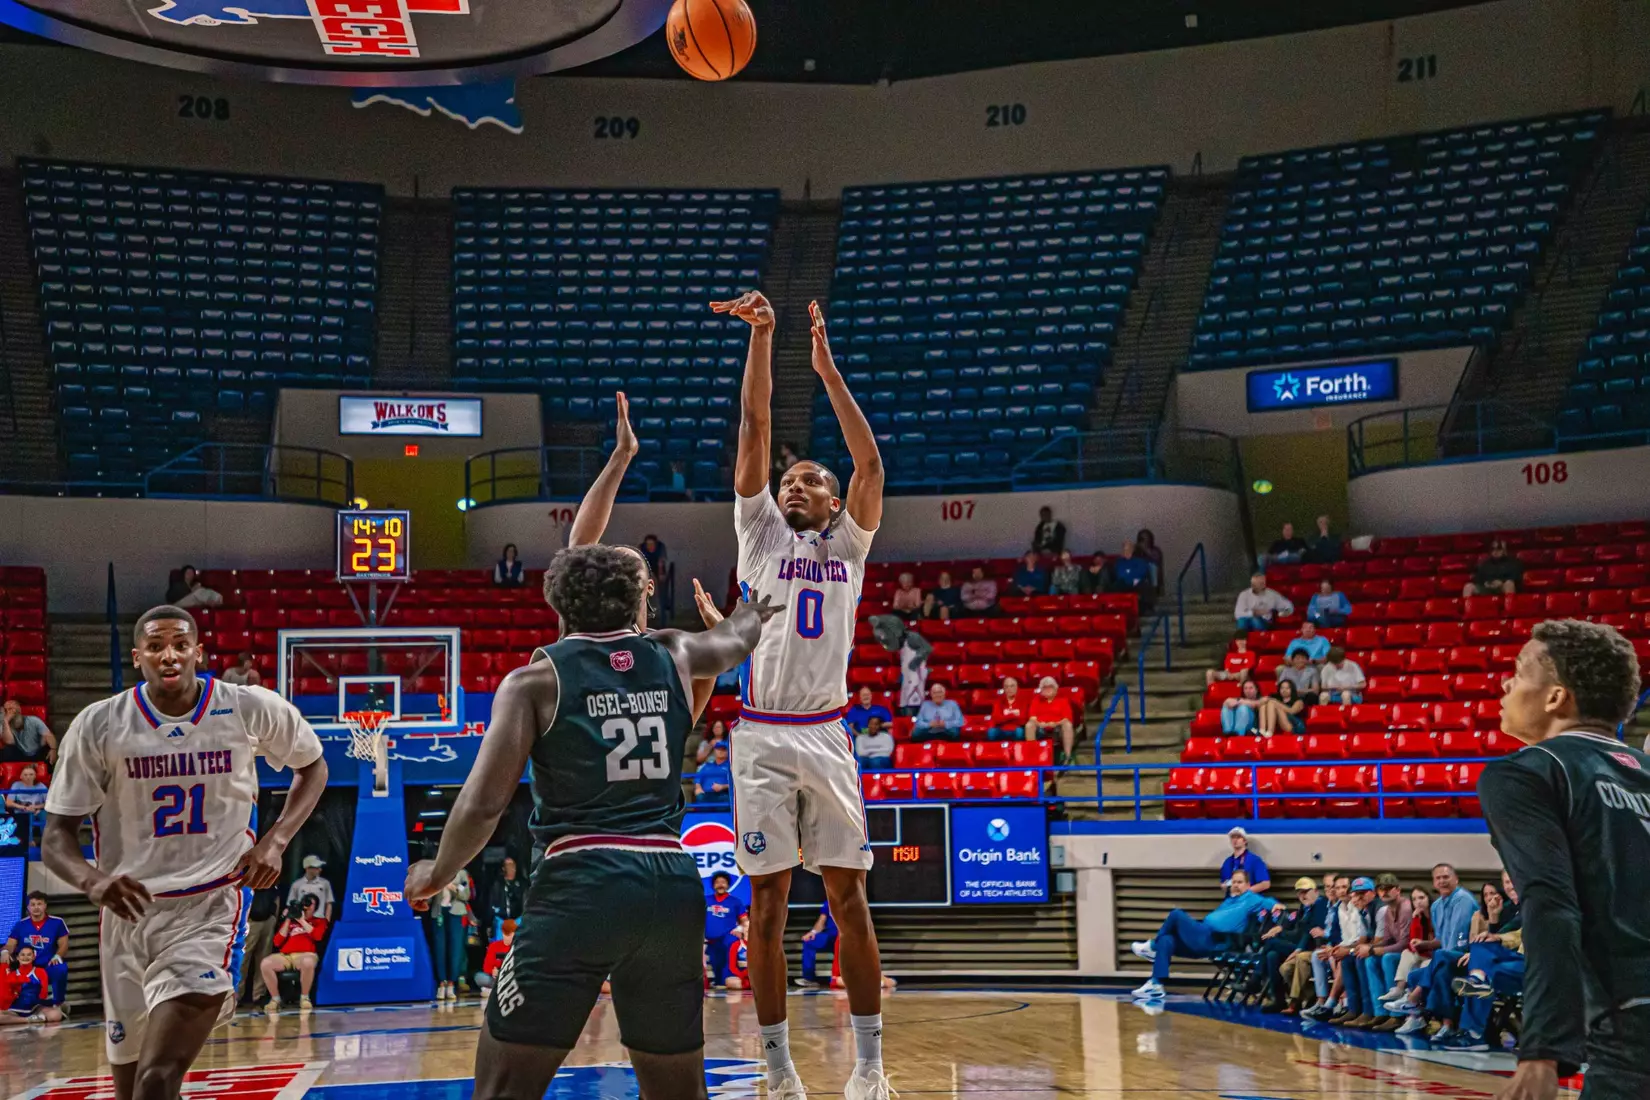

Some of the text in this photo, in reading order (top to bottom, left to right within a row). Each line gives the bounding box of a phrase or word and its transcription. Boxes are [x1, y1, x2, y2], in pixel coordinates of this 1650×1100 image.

[1397, 54, 1436, 82] 211
[178, 95, 230, 120] 208
[986, 103, 1027, 127] 210
[594, 116, 639, 139] 209
[1306, 372, 1368, 396] Forth
[1521, 460, 1568, 486] 108
[548, 508, 573, 529] 10
[941, 500, 975, 522] 107
[353, 518, 401, 537] 14:10
[352, 538, 395, 571] 23
[824, 560, 848, 583] TECH
[796, 588, 824, 639] 0
[586, 690, 668, 717] OSEI-BONSU
[601, 716, 670, 782] 23
[125, 750, 232, 779] LOUISIANA TECH
[152, 783, 207, 838] 21
[893, 847, 919, 861] MSU
[959, 847, 1040, 865] Origin Bank
